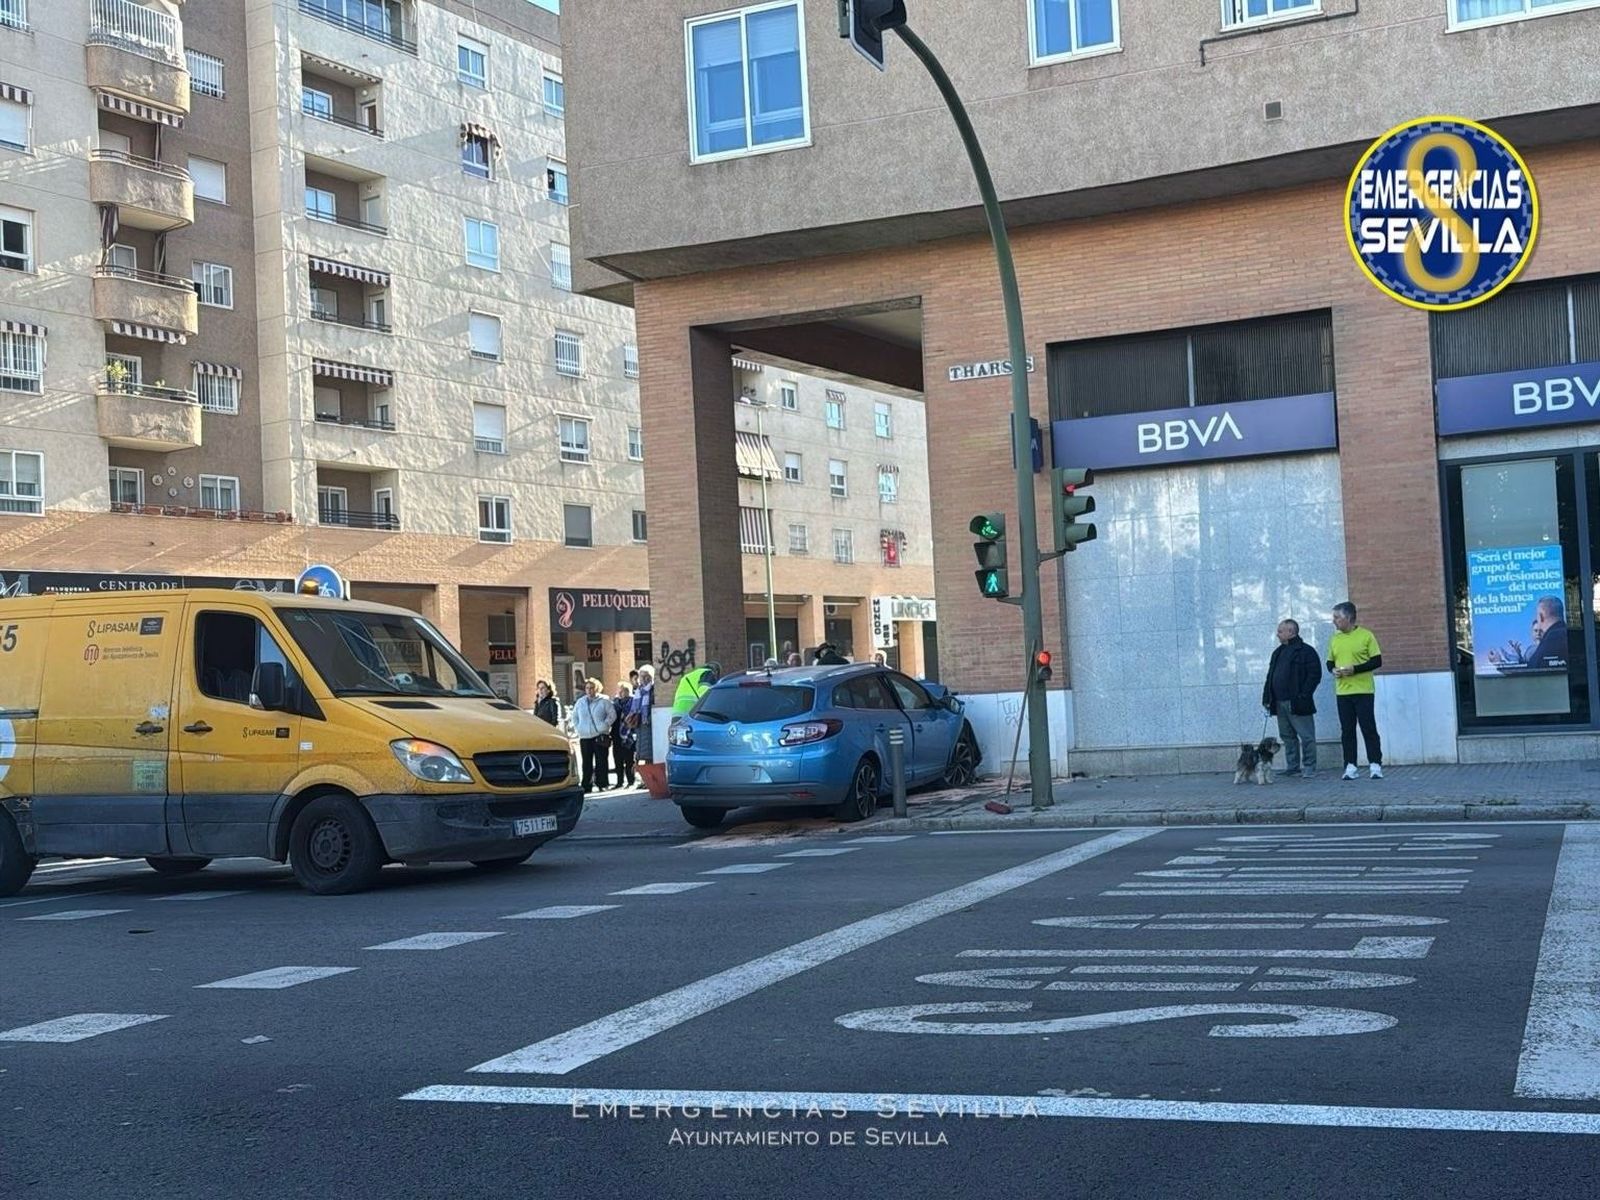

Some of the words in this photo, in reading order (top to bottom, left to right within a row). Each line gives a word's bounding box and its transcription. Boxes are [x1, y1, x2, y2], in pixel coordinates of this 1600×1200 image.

[950, 358, 1032, 379] THARSS
[1138, 411, 1243, 453] BBVA
[1502, 551, 1512, 561] el
[1514, 549, 1546, 561] mejor
[1471, 564, 1505, 575] grupo
[1506, 561, 1520, 571] de
[1486, 569, 1561, 585] profesionales
[99, 580, 157, 592] CENTRO
[1508, 581, 1526, 592] del
[1527, 581, 1561, 591] sector
[1473, 594, 1487, 604] de
[1488, 592, 1499, 603] la
[1500, 592, 1534, 602] banca
[873, 599, 881, 635] MUNDO
[97, 622, 139, 633] LIPASAM
